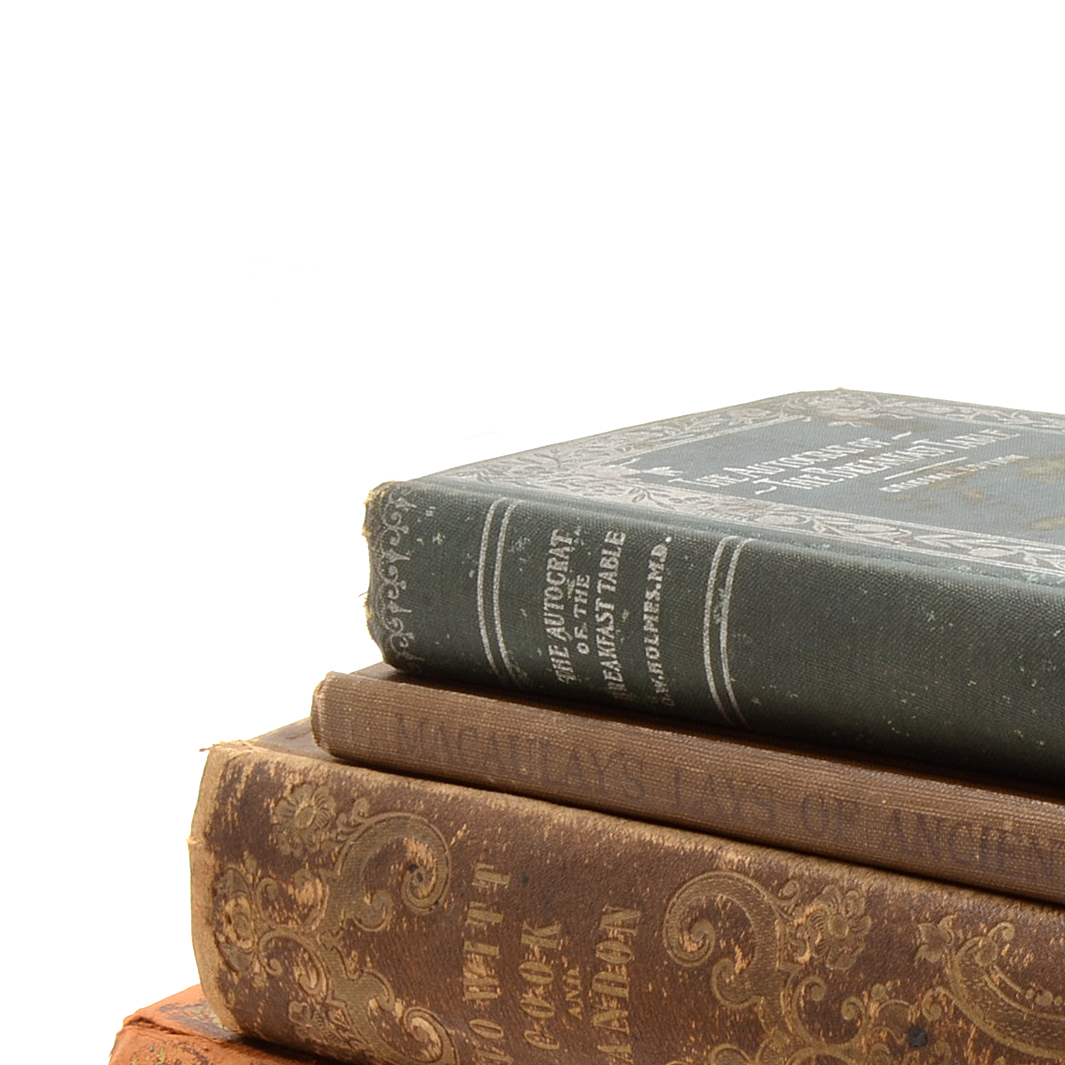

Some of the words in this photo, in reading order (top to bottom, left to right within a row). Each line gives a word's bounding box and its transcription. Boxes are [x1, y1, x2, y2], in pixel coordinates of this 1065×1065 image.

[544, 528, 574, 641] AUTOCRAT
[596, 530, 627, 594] TABLE
[573, 574, 590, 619] THE
[548, 645, 577, 683] THE
[574, 624, 590, 655] OF
[671, 765, 780, 828] LAYS
[799, 794, 861, 846] OF
[518, 920, 562, 1050] COOK
[562, 966, 583, 1020] AND
